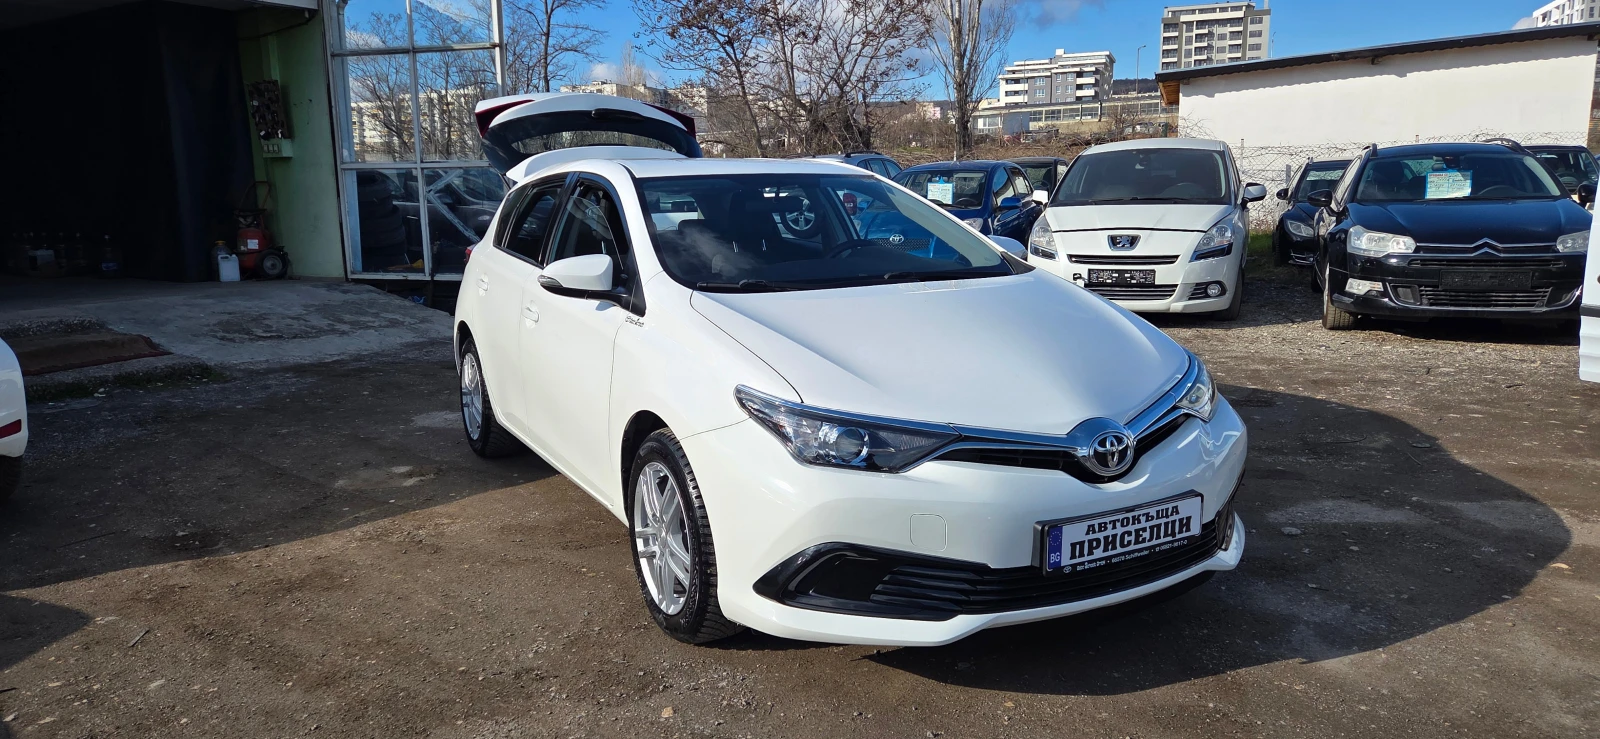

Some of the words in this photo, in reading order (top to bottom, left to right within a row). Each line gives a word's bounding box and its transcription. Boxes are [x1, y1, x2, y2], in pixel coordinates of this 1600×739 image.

[1085, 505, 1180, 535] АВТОКЪЩА
[1069, 516, 1192, 560] ПРИСЕЛЦИ
[1050, 552, 1060, 563] BG
